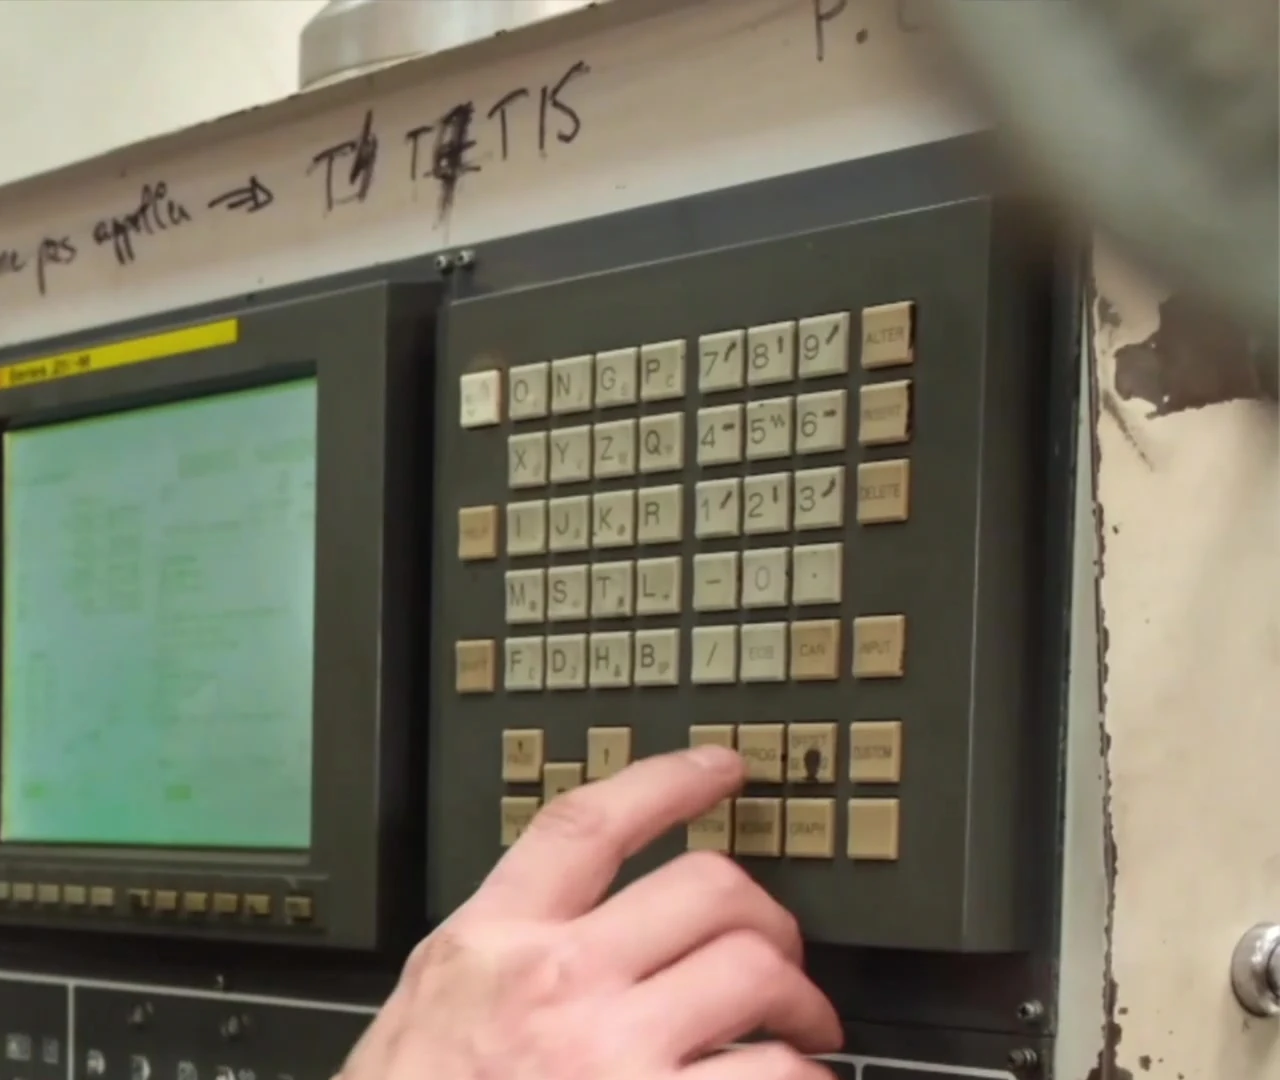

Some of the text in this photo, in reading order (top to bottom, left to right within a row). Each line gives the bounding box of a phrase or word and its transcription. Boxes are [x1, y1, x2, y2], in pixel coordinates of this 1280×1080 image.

[36, 236, 77, 296] pas
[556, 372, 571, 396] N
[600, 366, 616, 391] G
[645, 358, 661, 385] P
[703, 351, 719, 377] 7
[752, 343, 770, 369] 8
[803, 334, 820, 360] 9
[865, 326, 905, 346] ALTER
[514, 449, 527, 473] X
[555, 442, 570, 464] Y
[600, 436, 614, 461] Z
[645, 429, 662, 456] Q
[700, 424, 716, 449] 4
[750, 418, 766, 444] 5
[800, 411, 817, 438] 6
[555, 512, 570, 536] J
[599, 506, 614, 531] K
[644, 502, 661, 527] R
[700, 498, 710, 522] 1
[748, 492, 764, 518] 2
[799, 486, 816, 512] 3
[509, 583, 526, 607] M
[552, 580, 568, 604] S
[597, 576, 611, 599] T
[643, 573, 657, 598] L
[509, 650, 523, 673] F
[552, 649, 567, 673] D
[595, 646, 610, 670] H
[640, 644, 656, 668] B
